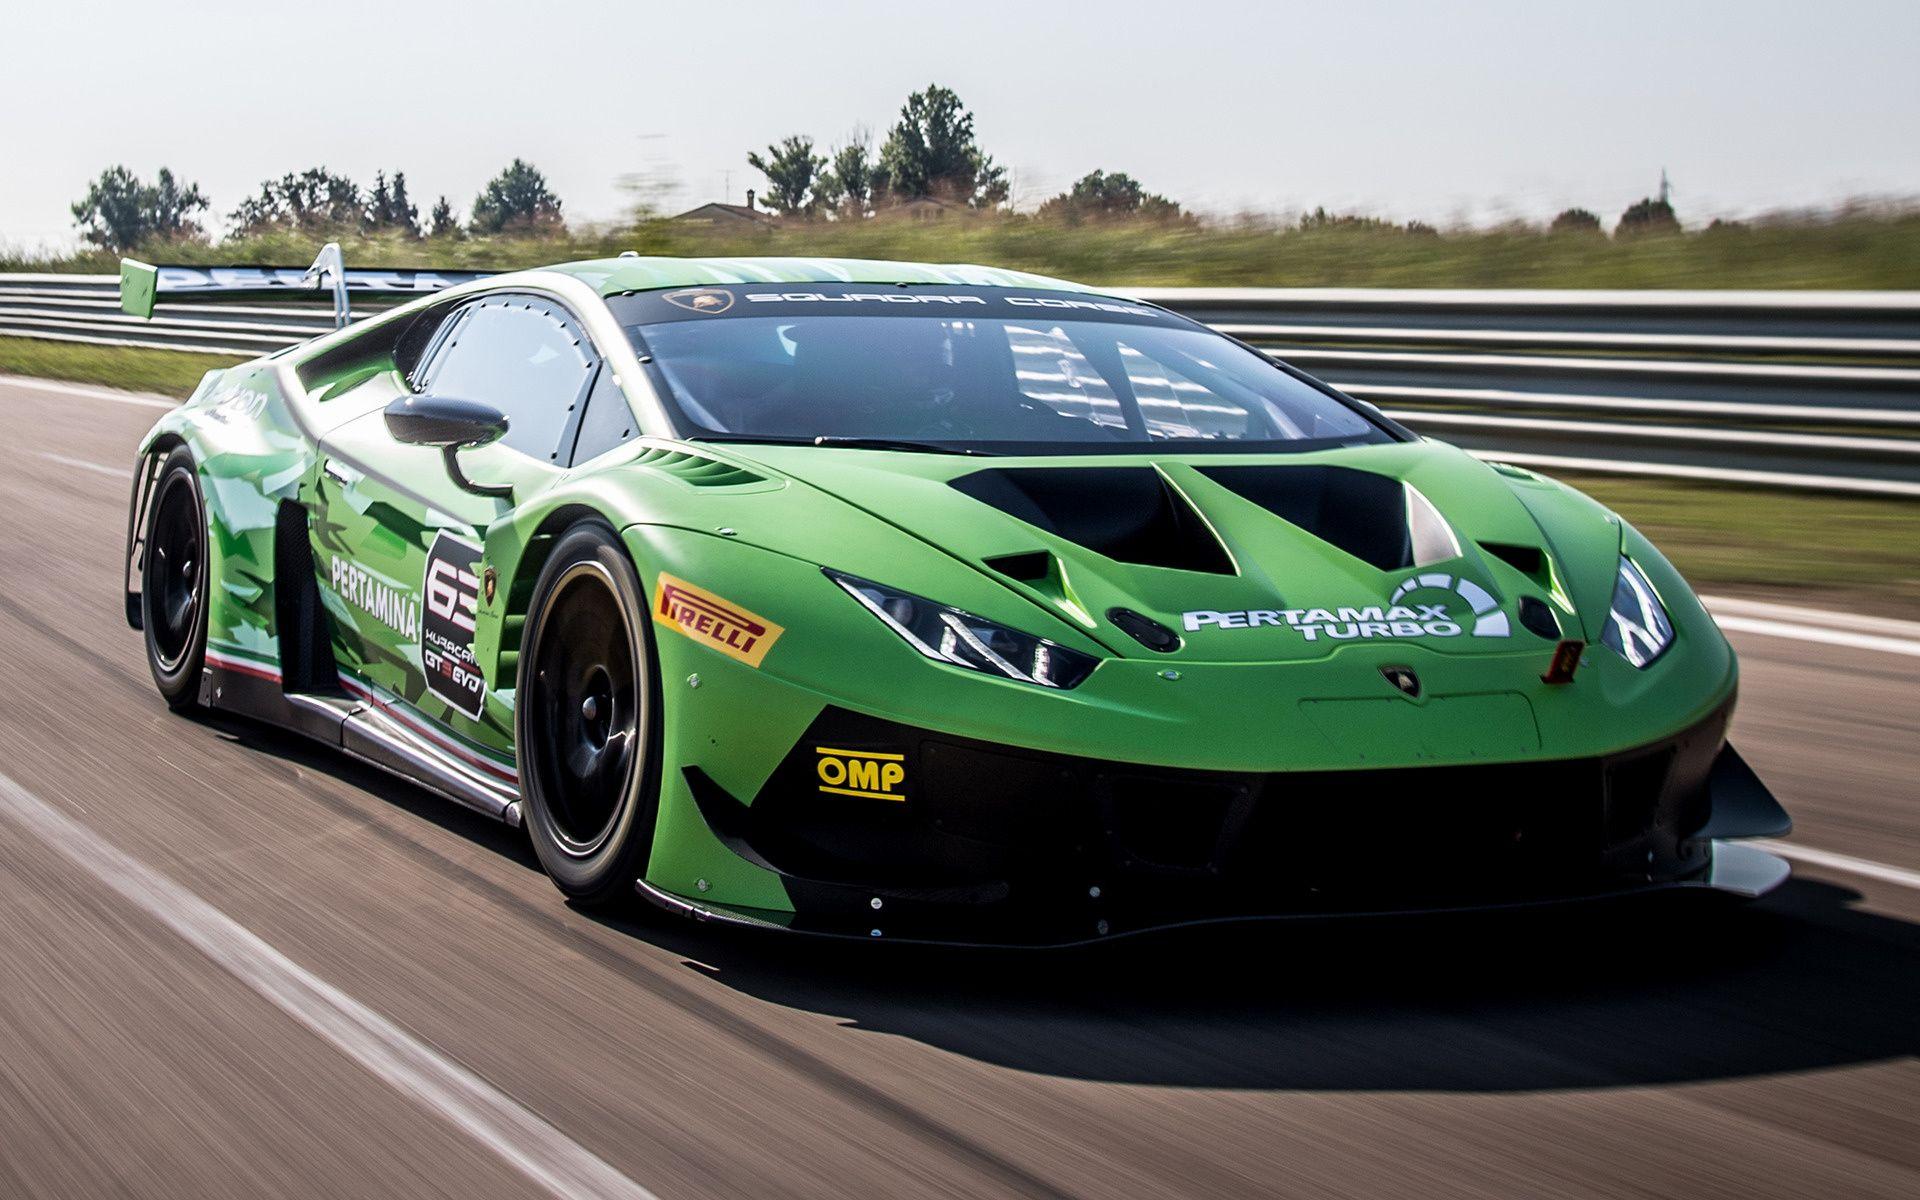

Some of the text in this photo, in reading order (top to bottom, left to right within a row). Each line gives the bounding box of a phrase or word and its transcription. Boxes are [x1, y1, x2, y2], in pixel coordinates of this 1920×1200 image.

[746, 293, 1159, 318] SQUADRA CORSE
[332, 555, 417, 642] PERTAMINA
[427, 557, 480, 631] 63
[661, 583, 767, 654] PIRELLI
[1182, 604, 1453, 632] PERTAMAX
[1292, 621, 1463, 641] TURBO
[817, 756, 905, 792] OMP
